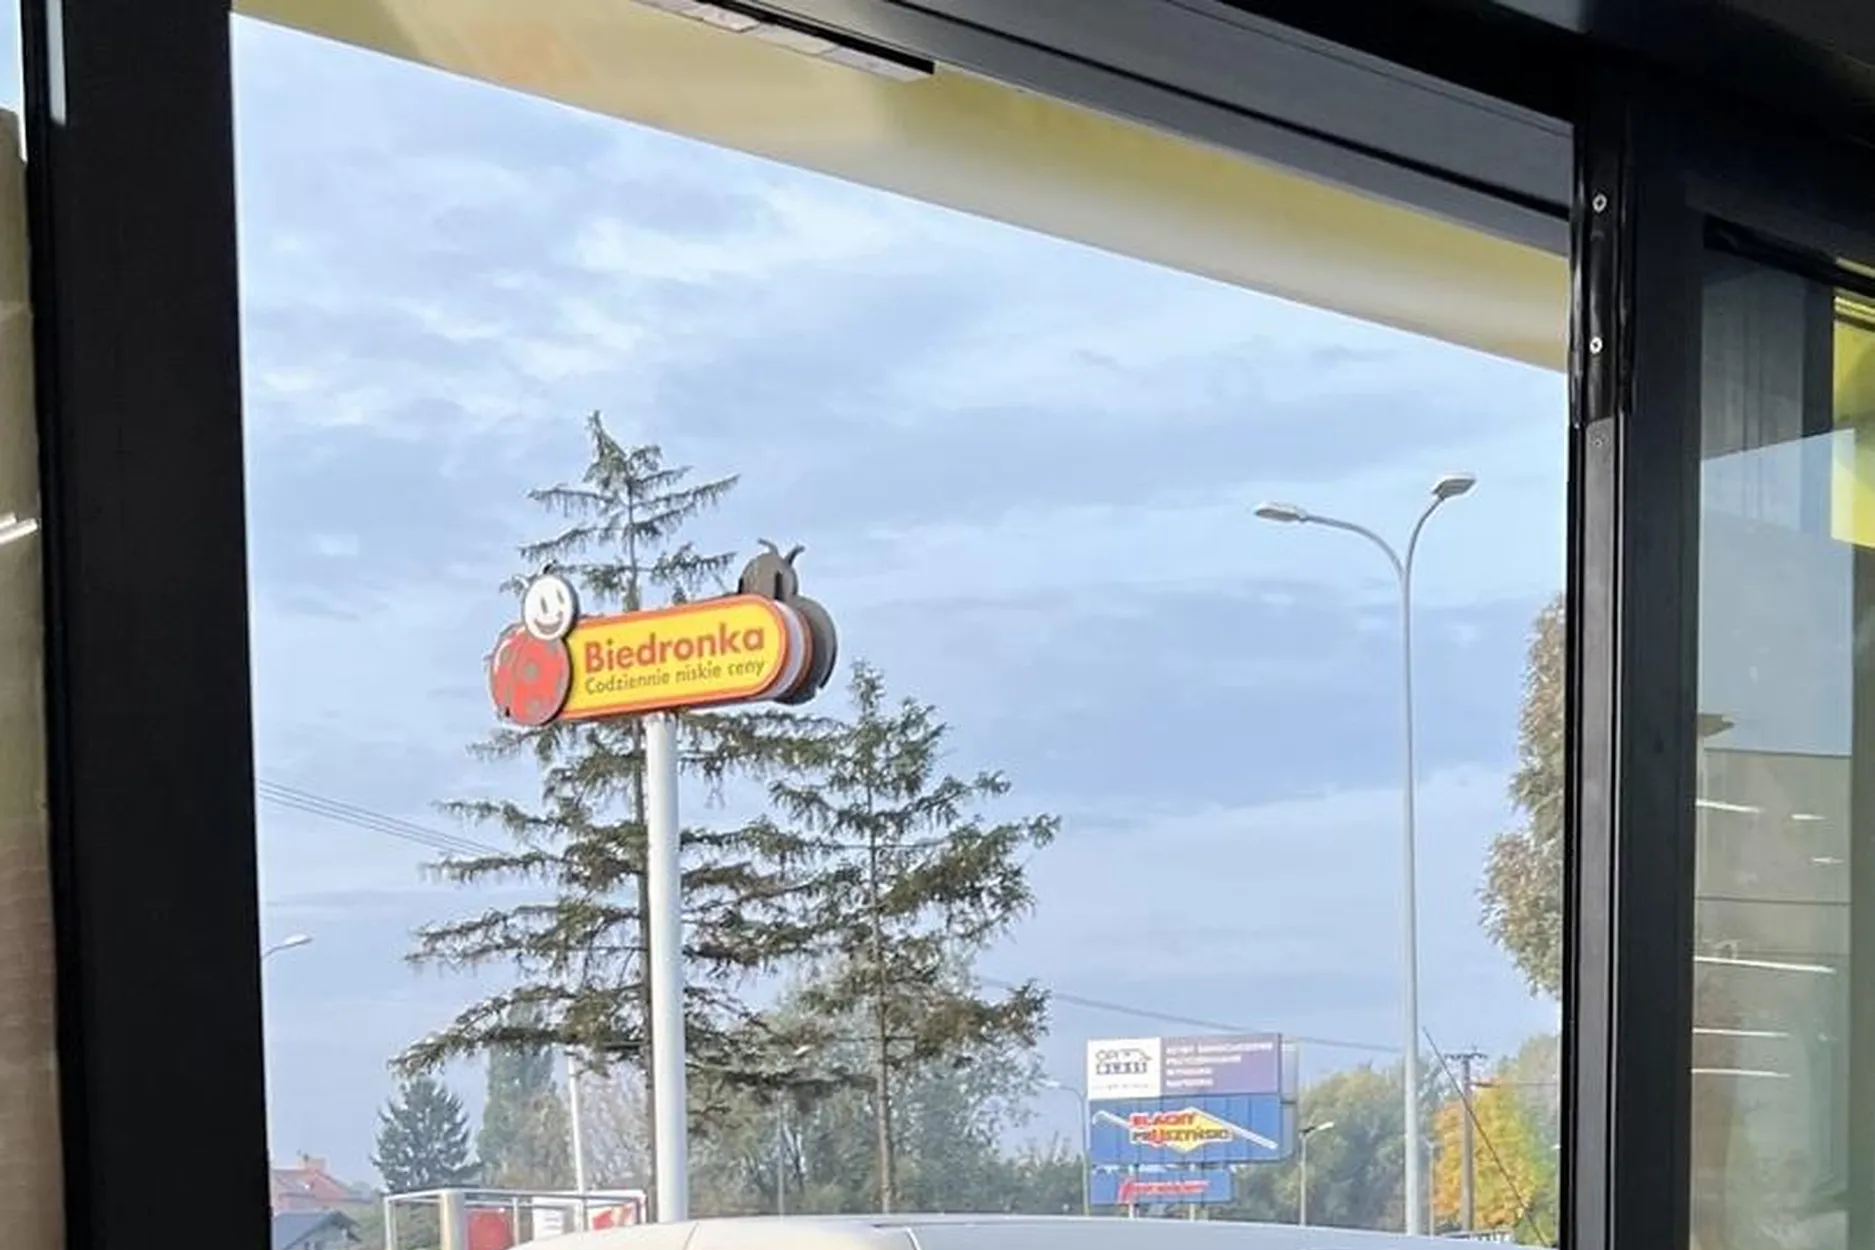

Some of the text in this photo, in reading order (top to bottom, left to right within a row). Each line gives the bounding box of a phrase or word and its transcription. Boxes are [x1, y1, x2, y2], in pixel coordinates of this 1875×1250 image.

[584, 621, 765, 675] Biedronka
[584, 658, 766, 696] Codziennie niskie ceny
